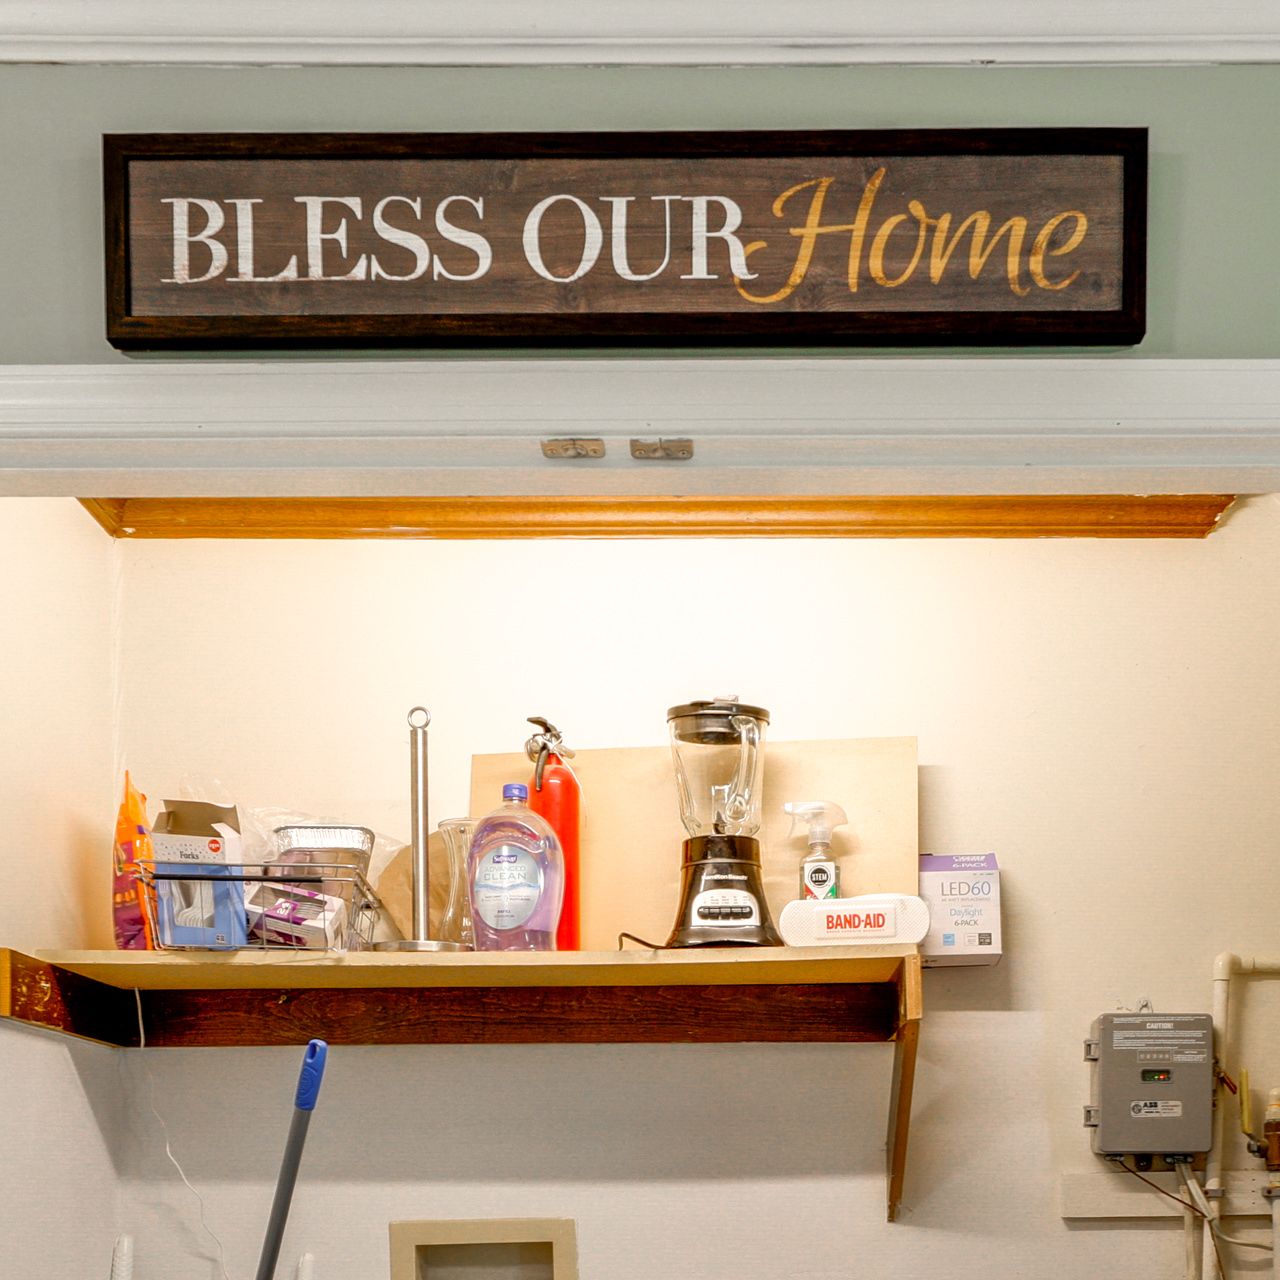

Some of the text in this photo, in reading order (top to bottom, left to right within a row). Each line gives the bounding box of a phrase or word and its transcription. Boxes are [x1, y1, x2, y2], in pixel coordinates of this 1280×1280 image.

[160, 167, 1090, 304] BLESS OUR Home
[179, 850, 200, 860] Forks
[483, 872, 527, 881] CLEAN
[811, 873, 828, 881] STEM
[941, 881, 992, 897] LED60
[949, 908, 983, 919] Daylight
[826, 913, 886, 930] BAND-AID
